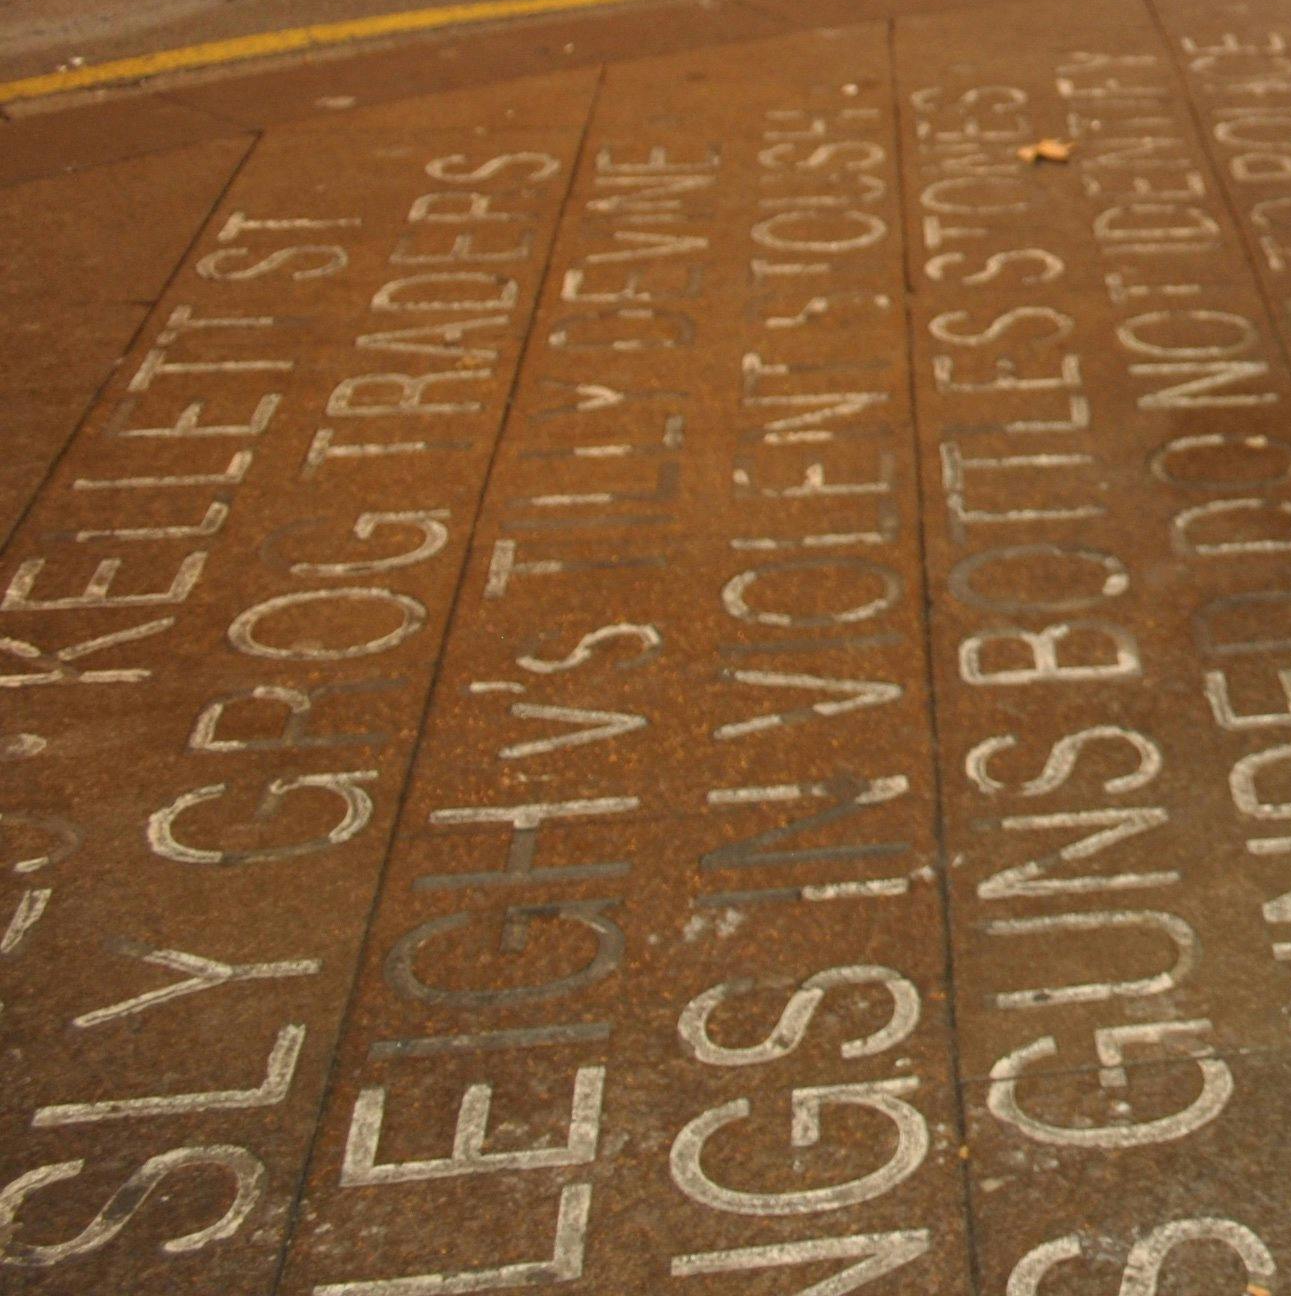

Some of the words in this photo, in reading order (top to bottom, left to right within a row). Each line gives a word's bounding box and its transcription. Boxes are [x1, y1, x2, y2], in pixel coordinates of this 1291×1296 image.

[303, 151, 561, 480] TRADERS
[910, 85, 1066, 285] STONES
[1055, 50, 1223, 253] IDENTIFY
[0, 304, 310, 688] KELLETT
[196, 211, 363, 282] ST
[928, 306, 1141, 686] BOTTLES
[1104, 270, 1279, 409] NOT
[147, 507, 451, 865] GROG
[312, 792, 640, 1296] LEIGH
[549, 139, 723, 350] DEVINE
[714, 352, 904, 737] VIOLENT
[0, 932, 322, 1267] SLY
[966, 725, 1234, 1148] GUNS
